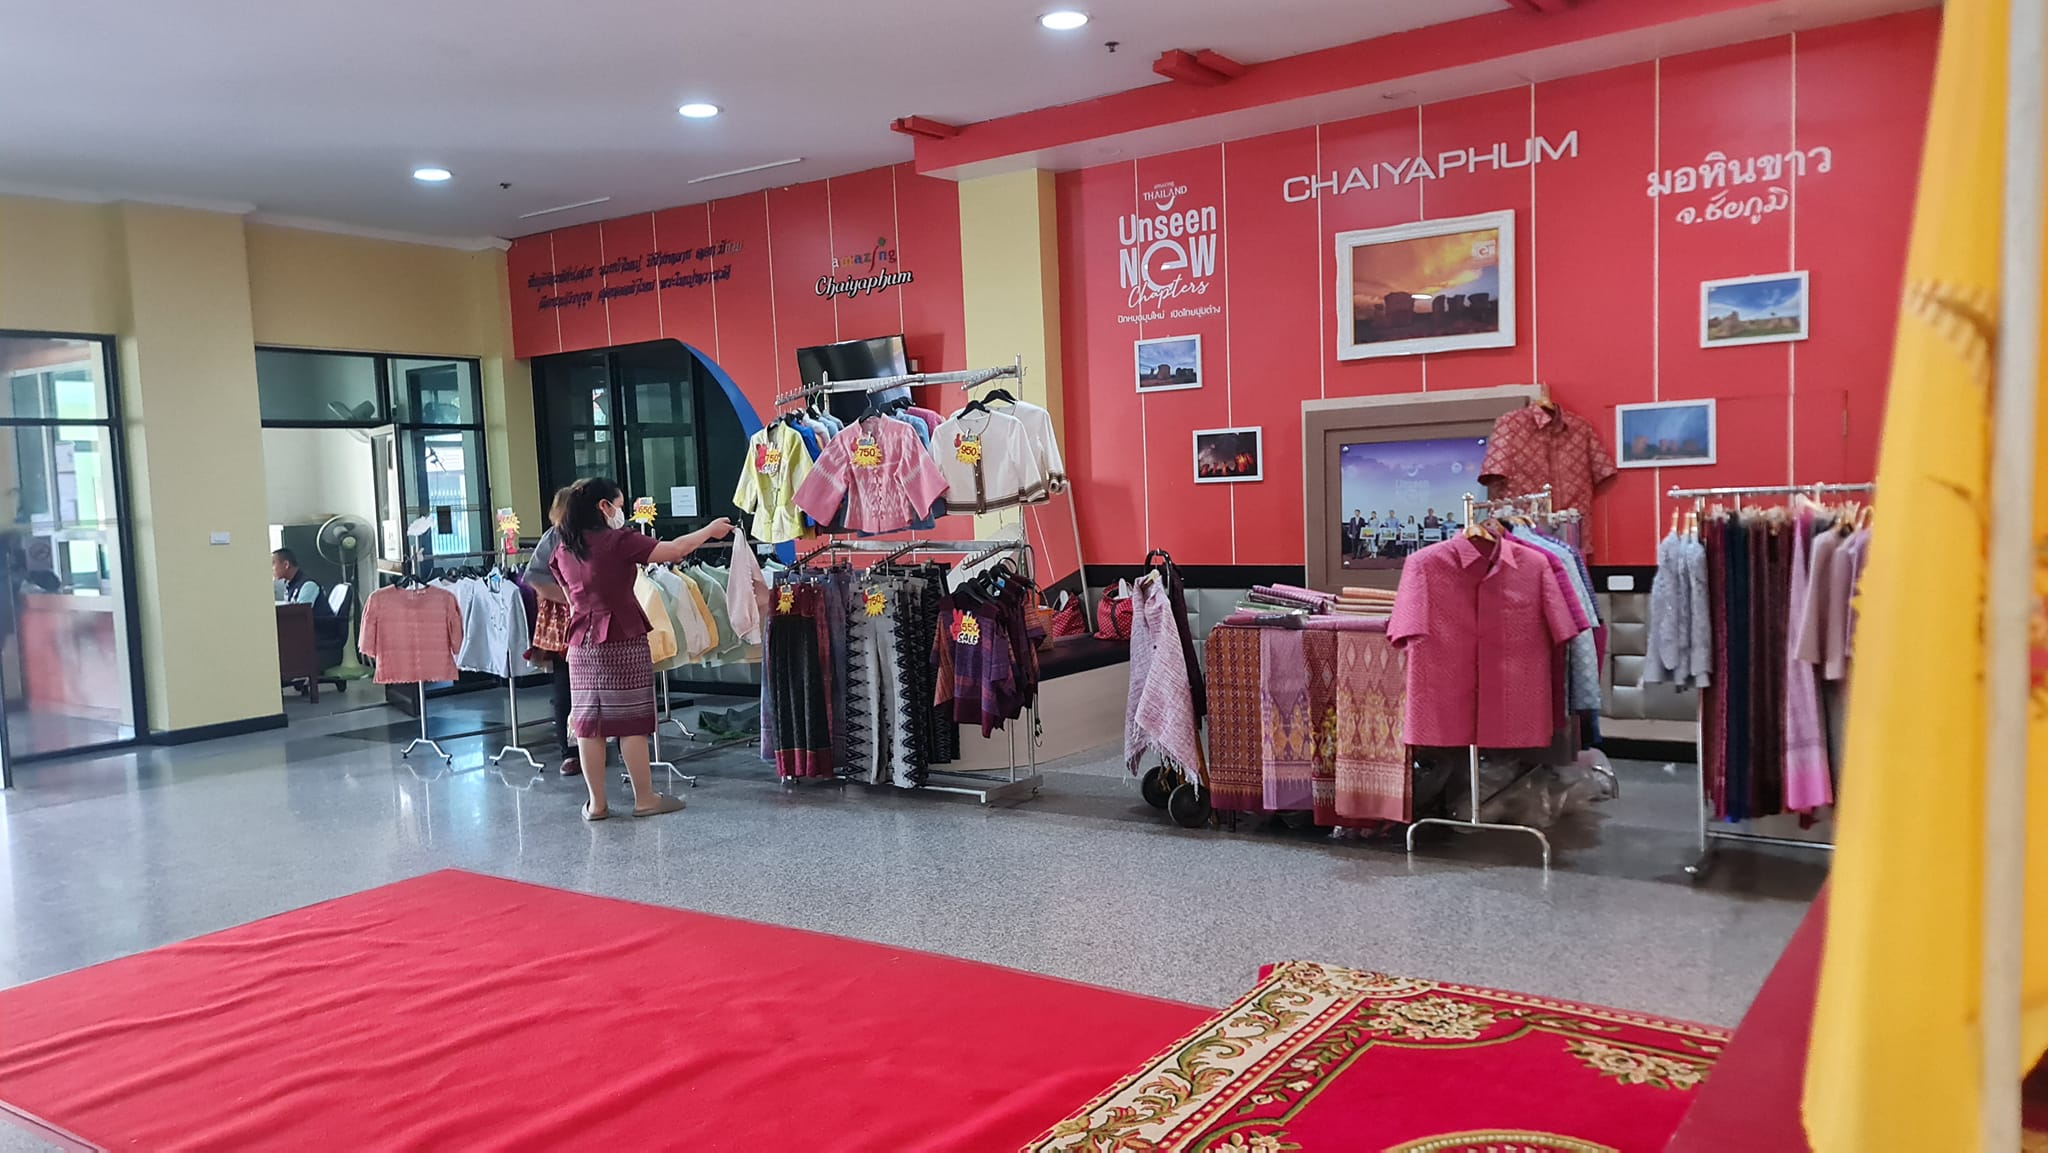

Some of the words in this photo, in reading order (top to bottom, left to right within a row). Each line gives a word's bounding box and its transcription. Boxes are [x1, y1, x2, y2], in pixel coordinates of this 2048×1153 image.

[1283, 130, 1578, 203] CHAIYAPHUM
[1646, 146, 1832, 198] มอหินขาว
[1143, 185, 1188, 201] THAILAND
[1675, 186, 1789, 225] จ.ชัยภูมิ
[1118, 206, 1217, 246] Unseen
[815, 267, 914, 300] Chaiyaphum
[1128, 273, 1210, 309] Chapters
[859, 447, 876, 457] 750
[961, 444, 977, 456] 950
[958, 632, 978, 644] SALE
[961, 622, 978, 632] 550
